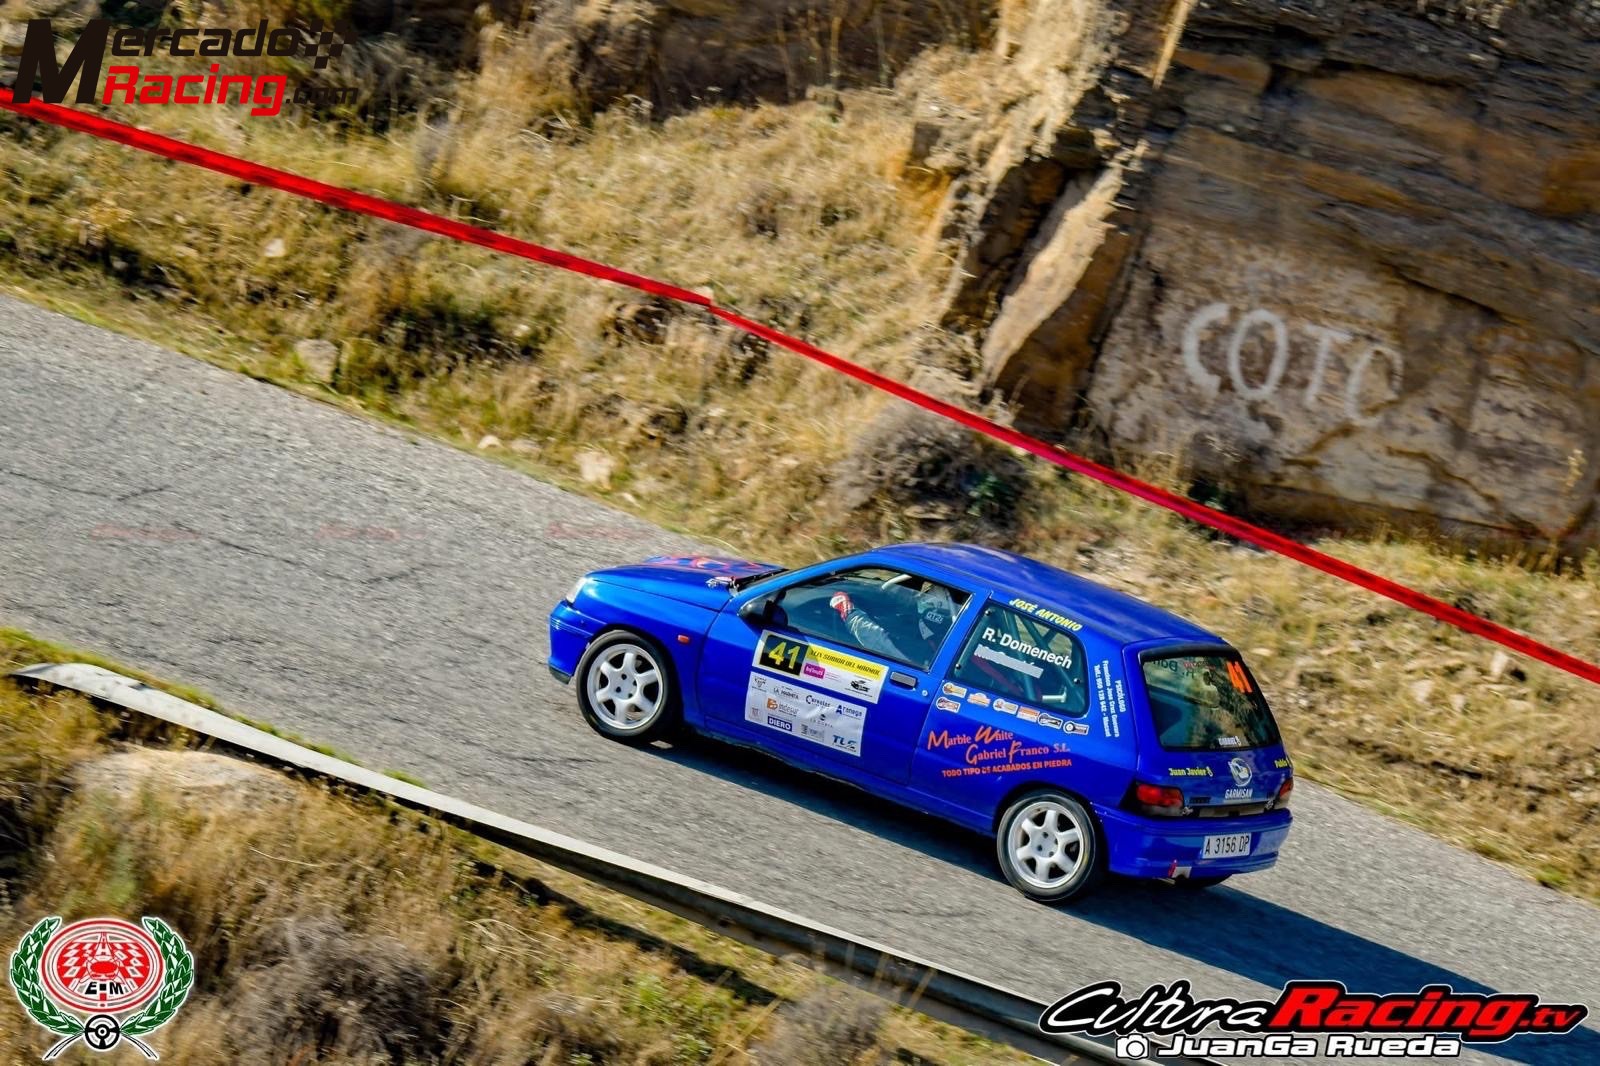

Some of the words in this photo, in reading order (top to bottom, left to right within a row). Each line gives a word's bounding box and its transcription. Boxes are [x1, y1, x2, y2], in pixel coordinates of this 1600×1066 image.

[1009, 598, 1038, 613] JOSÉ
[1035, 608, 1083, 632] ANTONIO
[768, 641, 801, 671] 41
[982, 627, 996, 643] R.
[1000, 633, 1073, 670] Domenech
[769, 717, 792, 731] DIERO
[927, 730, 972, 750] Marble
[974, 725, 1014, 744] White
[965, 743, 1006, 765] Gabriel
[1008, 740, 1050, 763] Franco
[1053, 743, 1071, 753] S.L.
[942, 770, 962, 778] TODO
[992, 762, 1031, 773] ACABADOS
[1032, 760, 1043, 769] EN
[1044, 758, 1073, 769] PIEDRA
[1168, 767, 1187, 776] Juan
[1186, 766, 1208, 776] Javier
[1224, 788, 1254, 800] GARMISAN
[1205, 838, 1211, 855] A
[1214, 837, 1237, 854] 3156
[1239, 835, 1250, 852] DP
